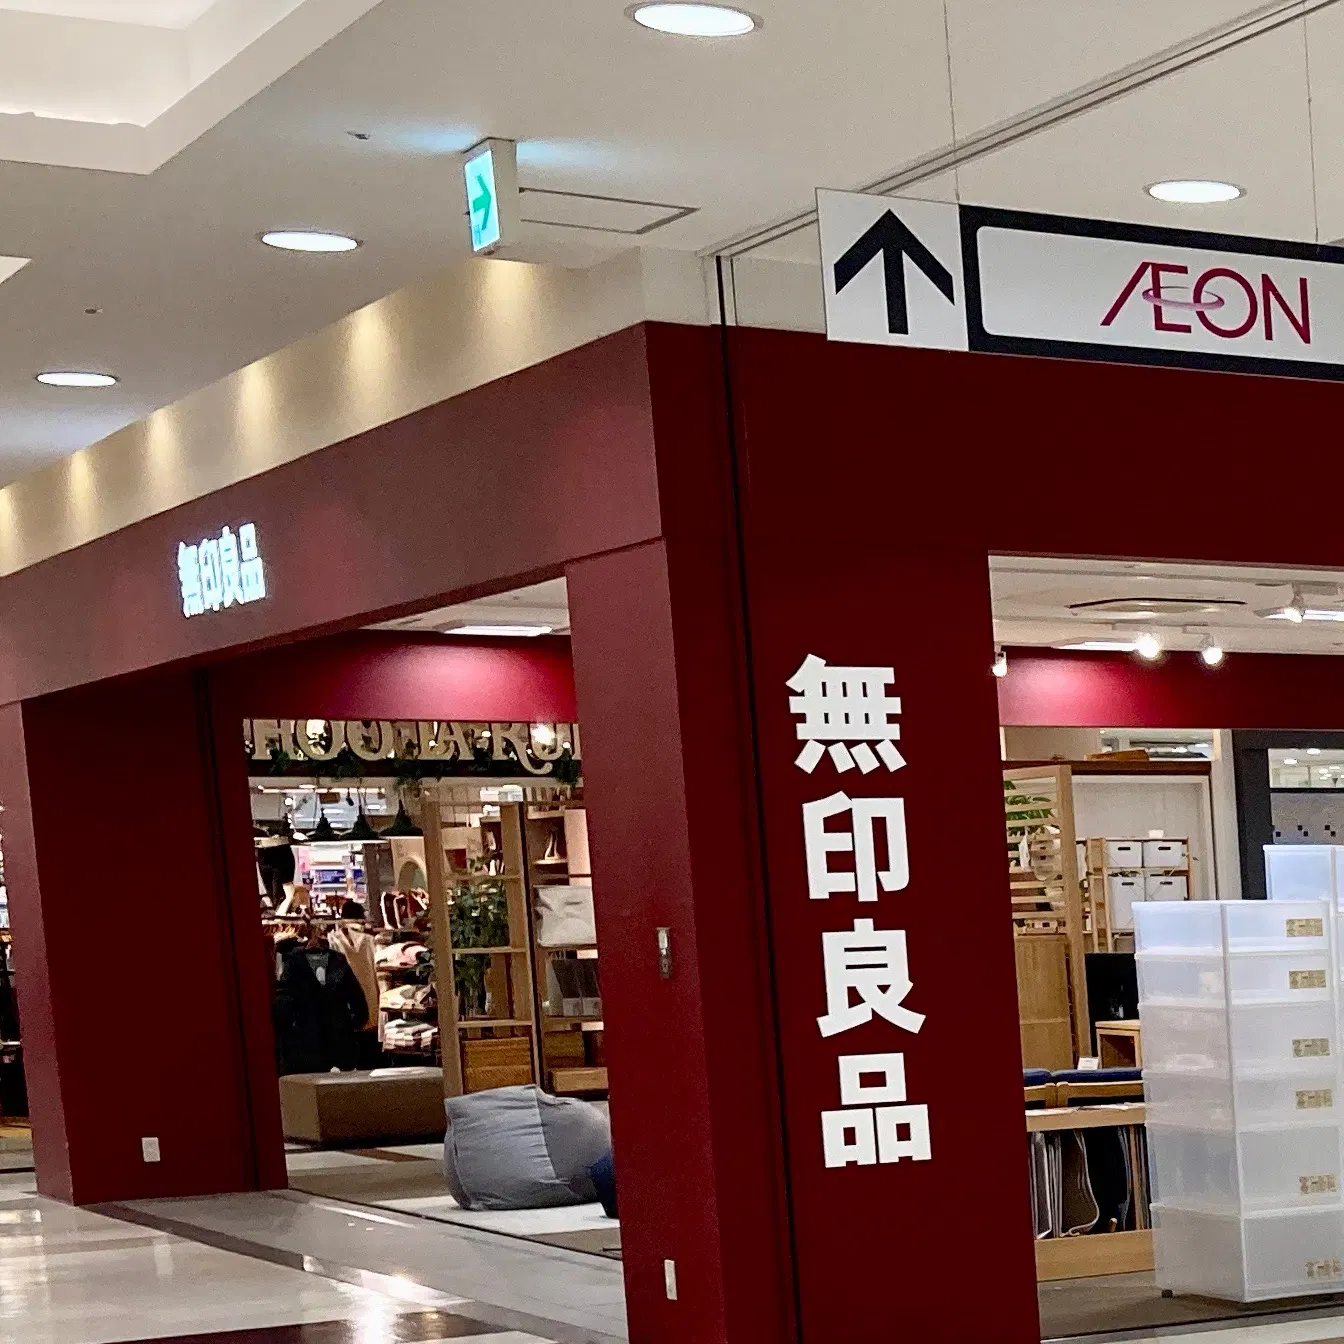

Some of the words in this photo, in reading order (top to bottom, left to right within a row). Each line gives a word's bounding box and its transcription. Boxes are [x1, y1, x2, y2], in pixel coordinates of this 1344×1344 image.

[178, 522, 265, 618] 無印良品
[785, 653, 932, 1168] 無印良品
